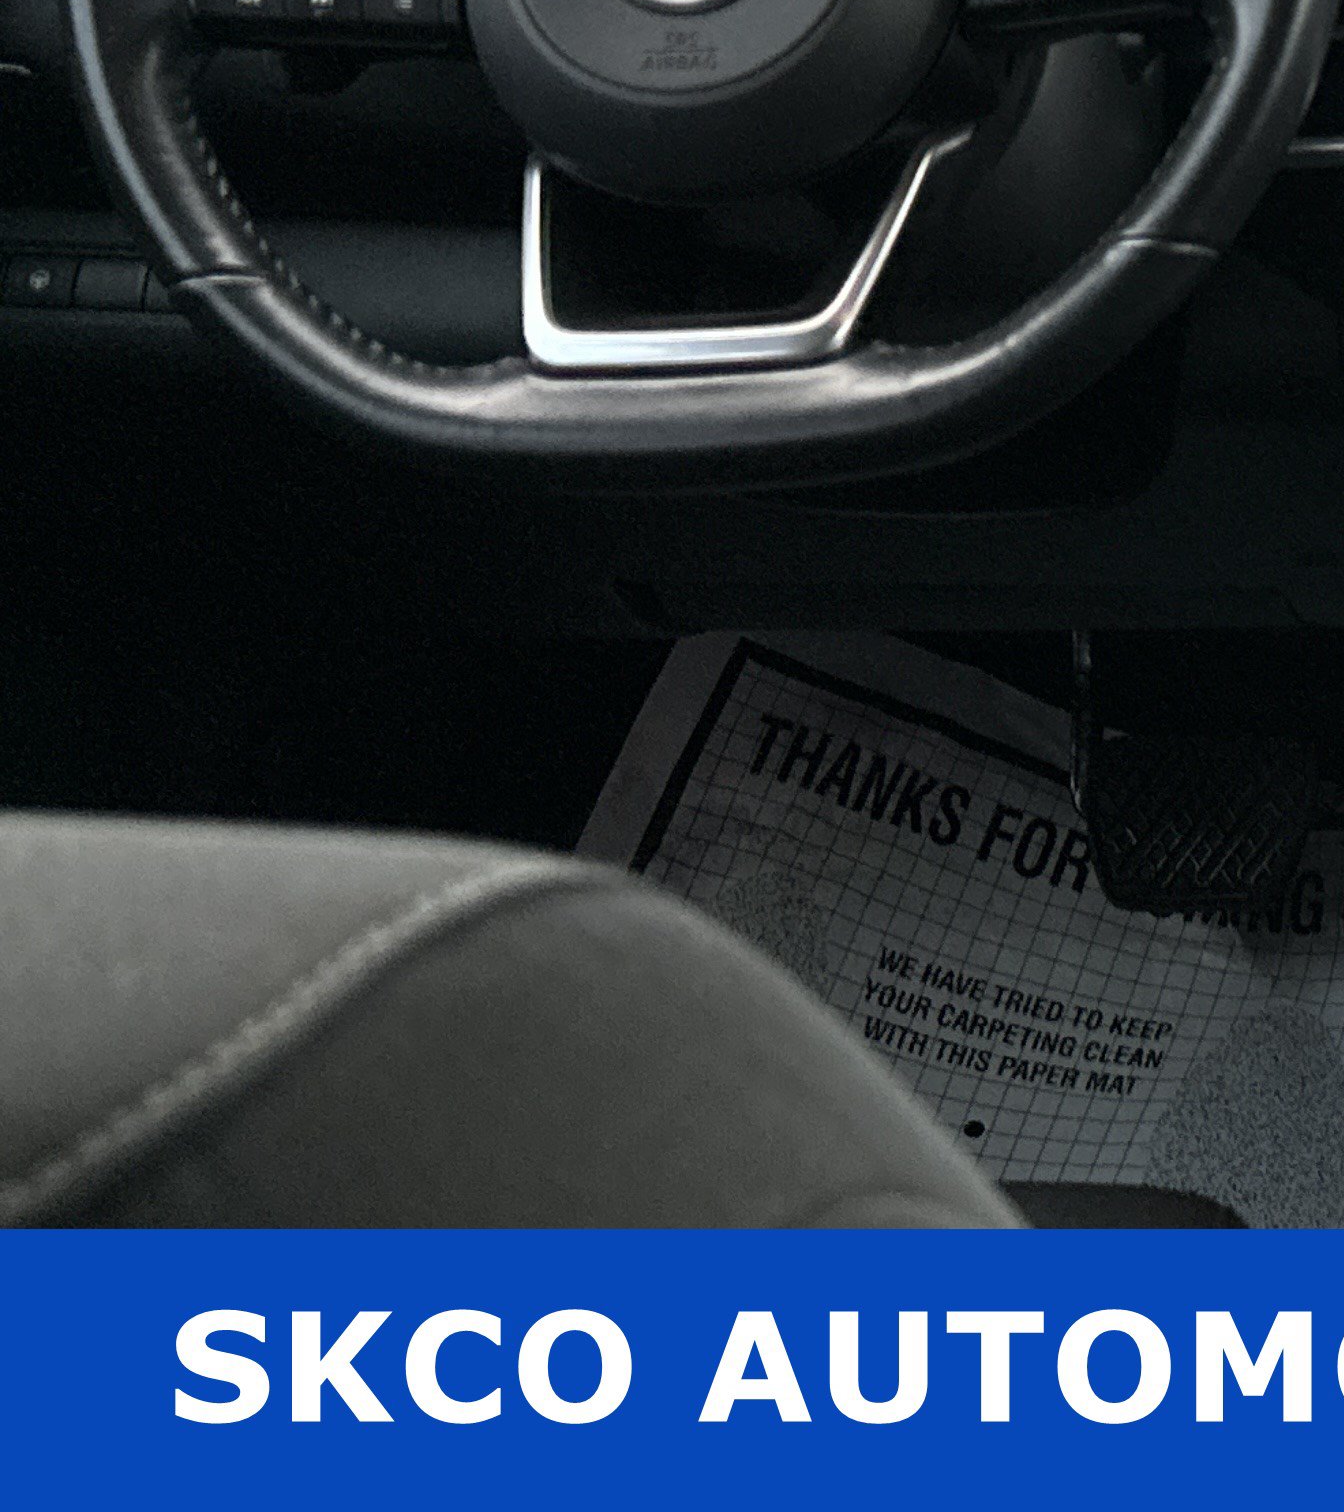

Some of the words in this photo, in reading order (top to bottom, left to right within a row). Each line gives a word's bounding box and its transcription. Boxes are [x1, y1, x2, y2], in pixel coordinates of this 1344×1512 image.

[749, 713, 972, 846] THANKS
[976, 804, 1093, 893] FOR
[863, 974, 932, 1021] YOUR
[936, 1002, 1079, 1058] CARPETING
[1083, 1040, 1164, 1068] CLEAN
[878, 944, 919, 979] WE
[921, 962, 990, 1002] HAVE
[994, 983, 1065, 1023] TRIED
[1071, 1004, 1104, 1032] TO
[1109, 1013, 1174, 1042] KEEP
[863, 1014, 929, 1057] WITH
[935, 1037, 993, 1073] THIS
[998, 1055, 1080, 1090] PAPER
[1084, 1071, 1143, 1096] MAT
